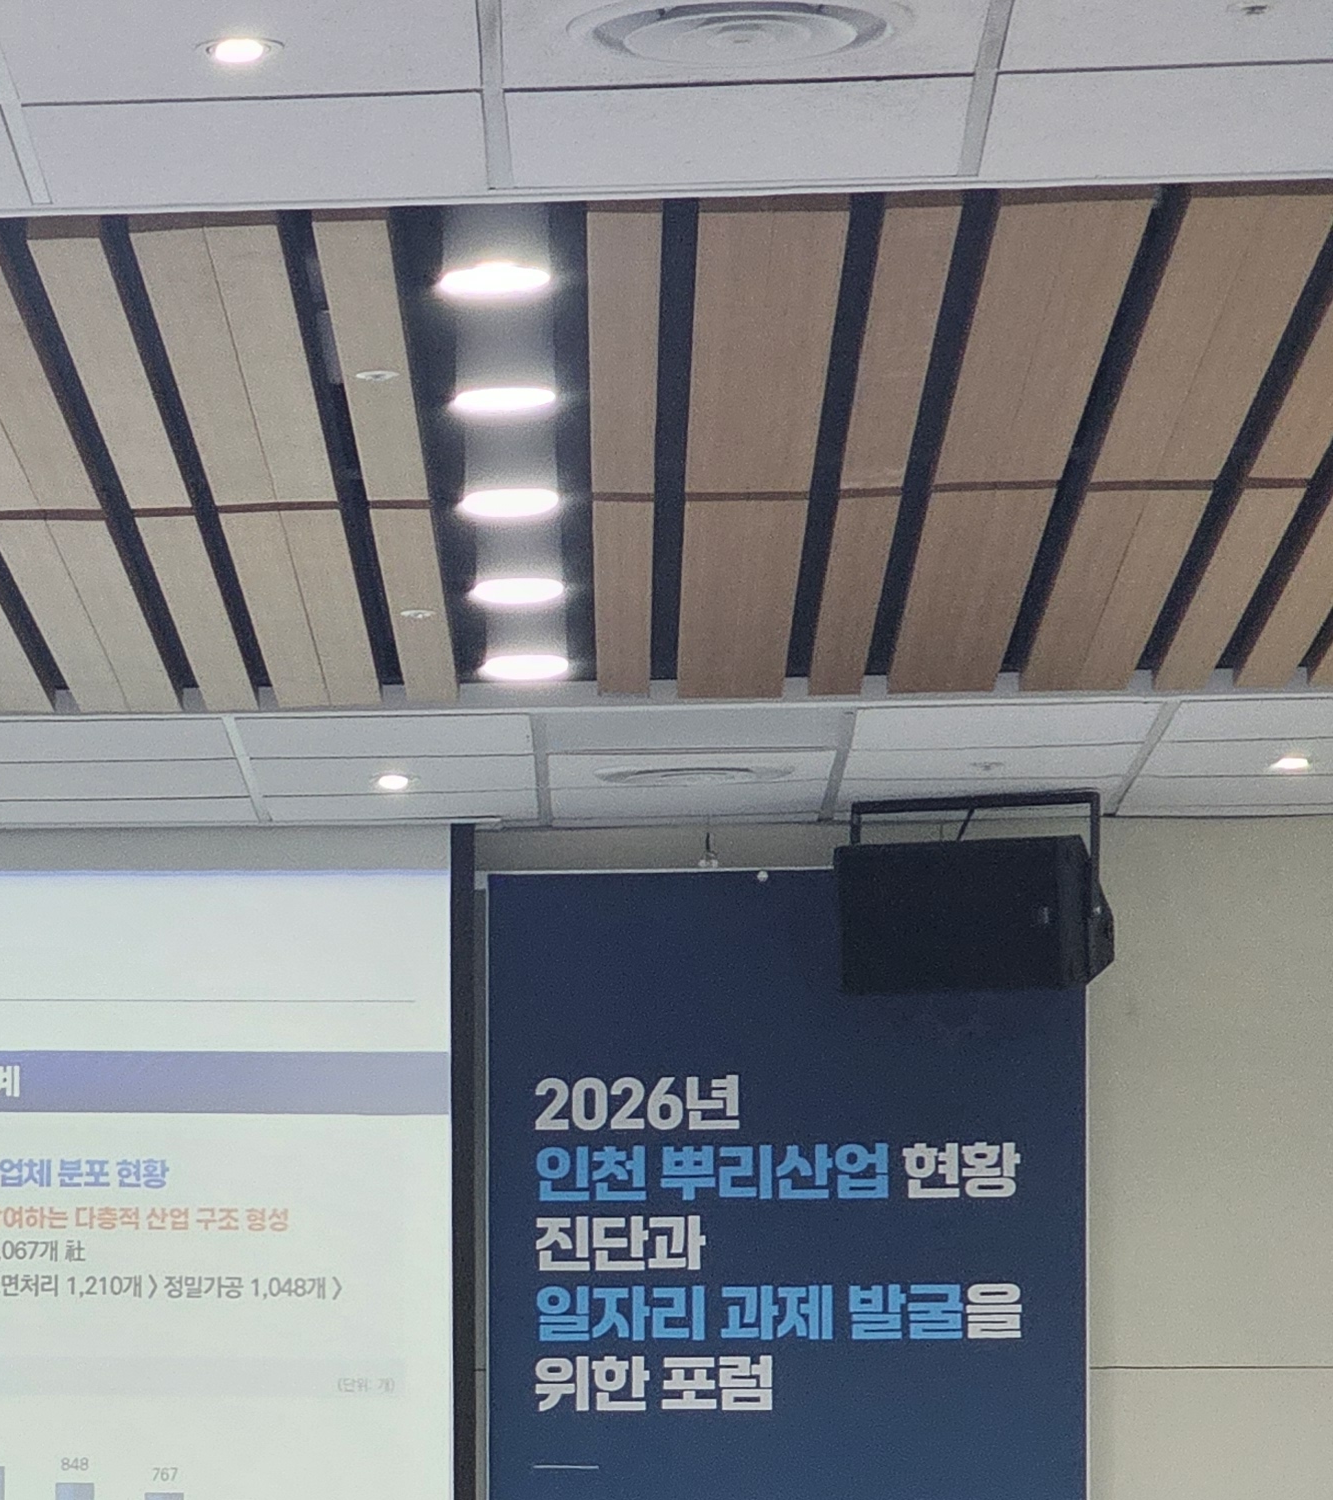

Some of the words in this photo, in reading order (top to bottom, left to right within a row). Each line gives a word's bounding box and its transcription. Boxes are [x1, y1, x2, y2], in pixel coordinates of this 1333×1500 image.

[535, 1075, 740, 1130] 2026년
[58, 1159, 110, 1187] 분포
[116, 1159, 169, 1189] 현황
[536, 1145, 646, 1201] 인천
[660, 1143, 889, 1200] 뿌리산업
[902, 1142, 1020, 1198] 현황
[75, 1207, 139, 1230] 다층적
[146, 1208, 189, 1230] 산업
[196, 1208, 239, 1230] 구조
[245, 1208, 288, 1232] 형성
[536, 1215, 706, 1271] 진단과
[67, 1275, 142, 1298] 1,210개
[164, 1276, 244, 1299] 정밀가공
[251, 1277, 326, 1299] 1,048개
[537, 1285, 705, 1341] 일자리
[721, 1285, 833, 1340] 과제
[849, 1283, 1022, 1339] 발굴을
[535, 1356, 650, 1411] 위한
[661, 1355, 772, 1410] 포럼
[61, 1457, 89, 1471] 848
[153, 1467, 178, 1482] 767
